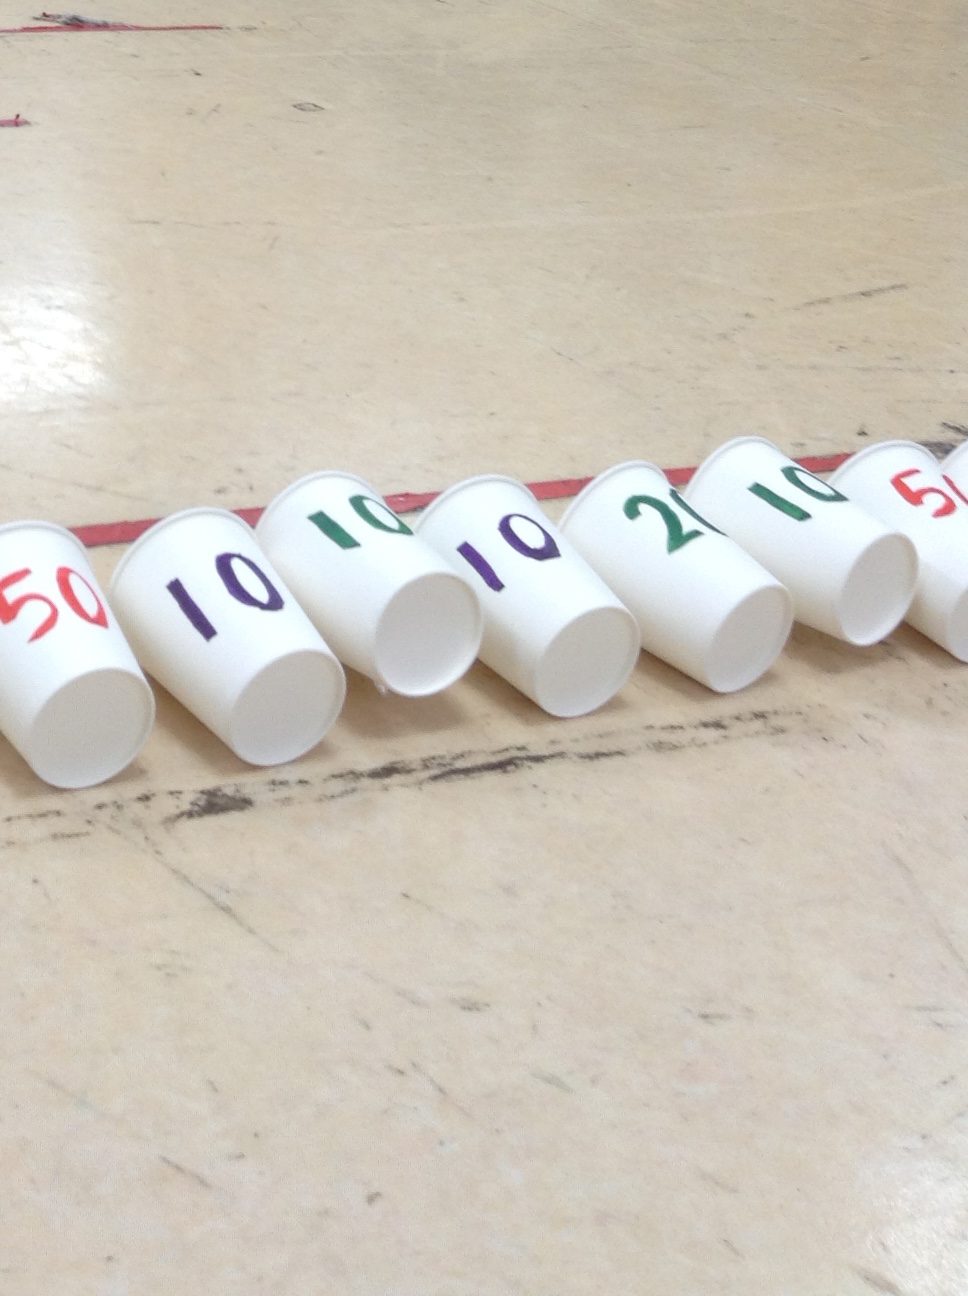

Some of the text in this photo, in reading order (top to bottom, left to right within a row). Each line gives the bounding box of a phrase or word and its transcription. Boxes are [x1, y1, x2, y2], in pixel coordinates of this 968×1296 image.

[747, 466, 850, 522] 10
[890, 468, 968, 518] 5
[307, 495, 414, 550] 10
[456, 513, 561, 593] 10
[166, 552, 285, 642] 10
